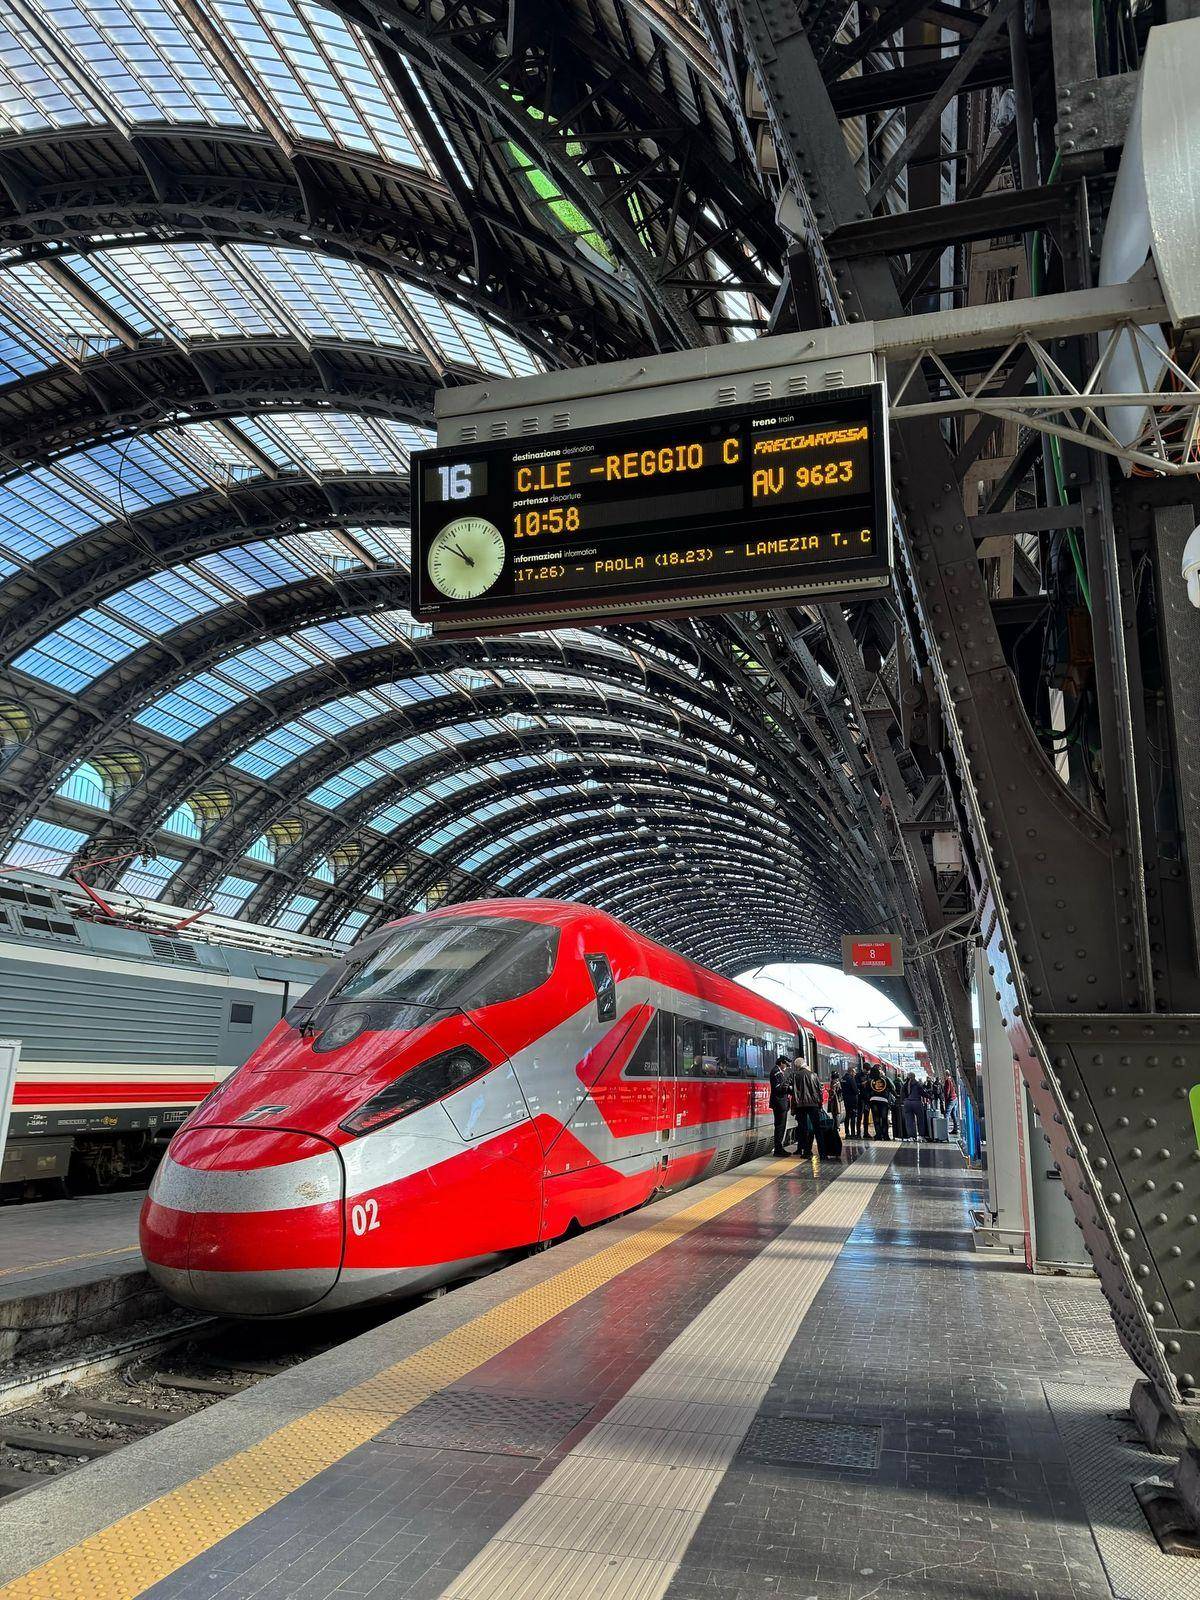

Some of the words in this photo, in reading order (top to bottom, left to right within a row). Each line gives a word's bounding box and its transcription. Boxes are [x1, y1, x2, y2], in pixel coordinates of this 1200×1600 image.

[752, 417, 777, 427] treno
[778, 414, 795, 424] train
[512, 449, 560, 462] destinazione
[562, 444, 595, 455] destination
[754, 426, 868, 454] FRECCIAROSSA
[517, 461, 571, 492] C.LE
[723, 438, 739, 465] C
[752, 467, 784, 497] AV
[796, 460, 853, 488] 9623
[438, 463, 472, 500] 16
[512, 496, 549, 509] partenza
[550, 492, 582, 503] departure
[513, 506, 580, 538] 10:58
[513, 551, 563, 563] informazioni
[564, 548, 597, 558] information
[595, 556, 644, 573] PAOLA
[655, 548, 713, 567] (18.23)
[746, 535, 819, 556] LAMEZIA
[831, 532, 848, 546] T.
[860, 529, 871, 543] C
[352, 1198, 380, 1236] 02
